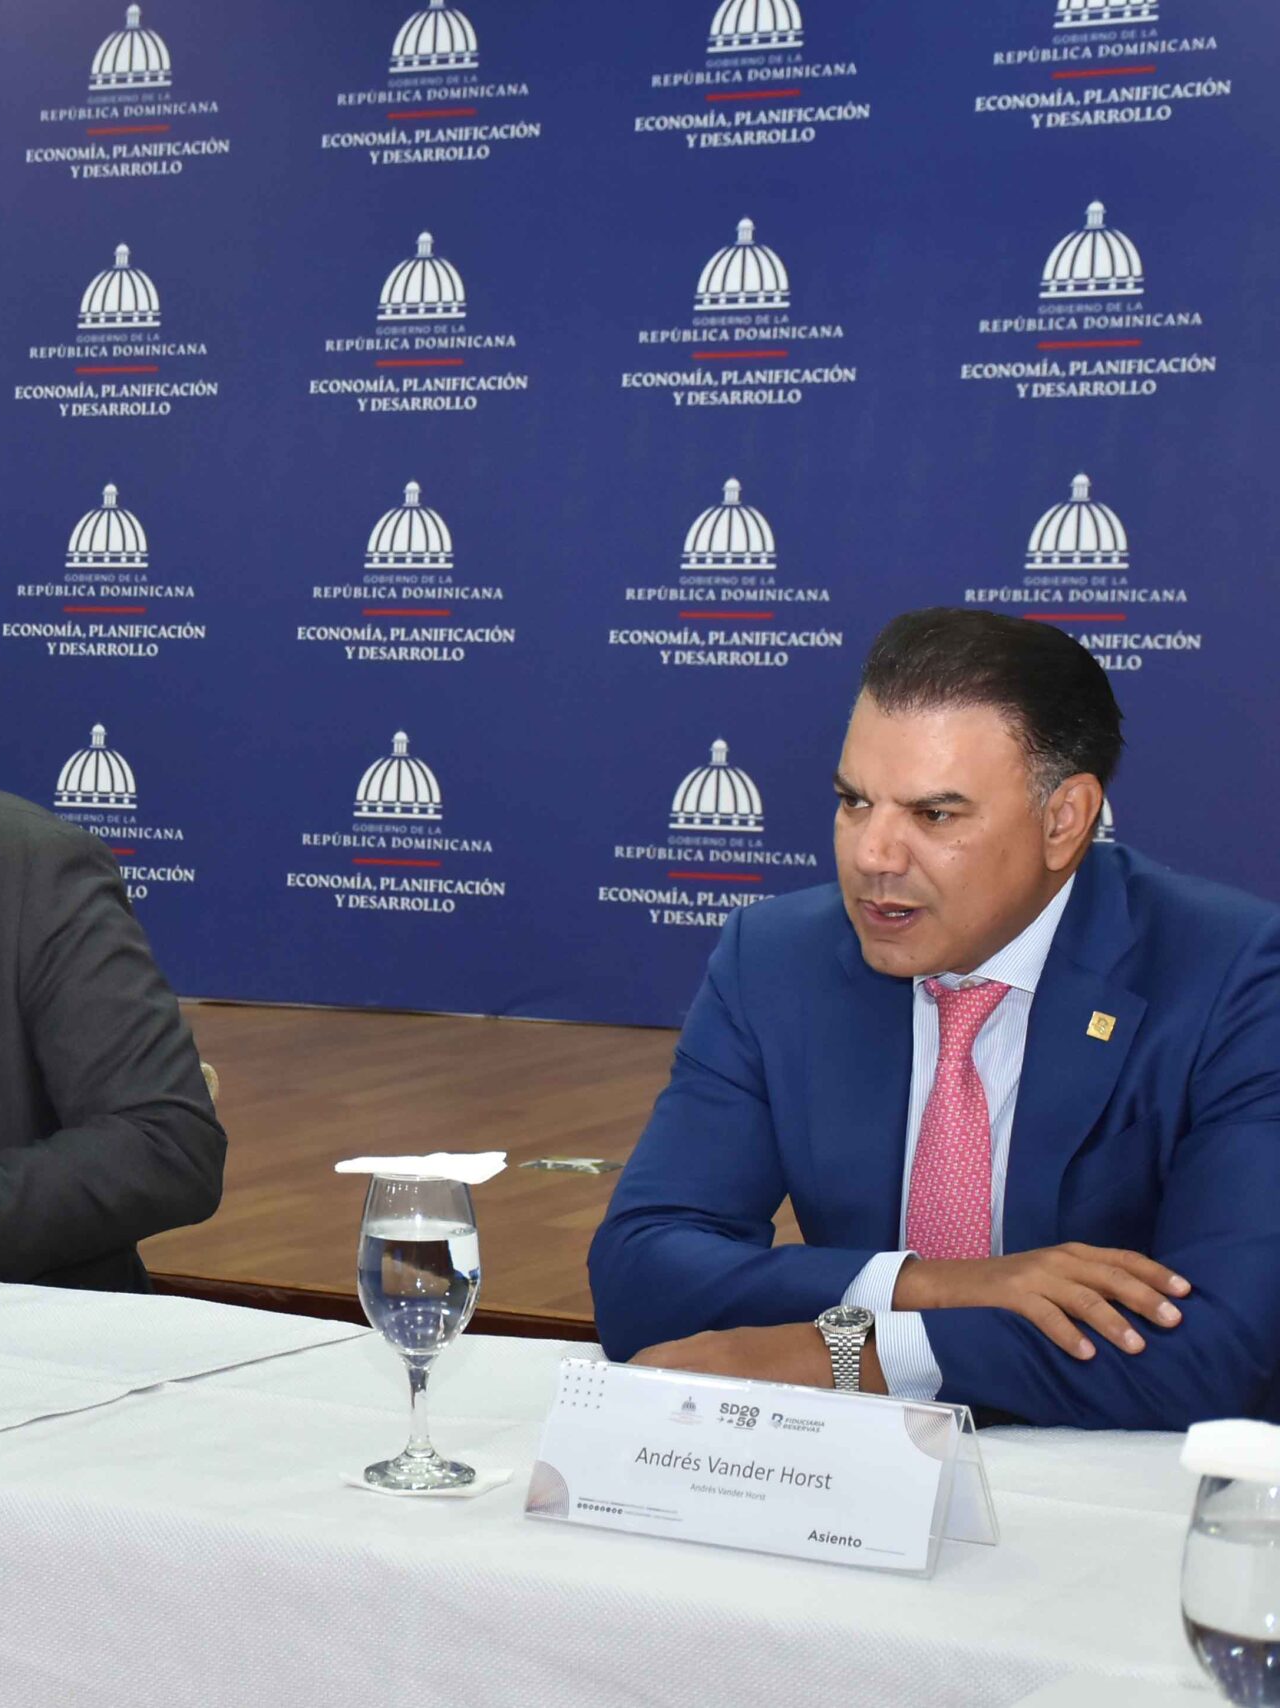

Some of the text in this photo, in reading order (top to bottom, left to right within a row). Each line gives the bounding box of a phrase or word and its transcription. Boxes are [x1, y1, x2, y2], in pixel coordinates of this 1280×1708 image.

[1052, 28, 1157, 44] GOBIERNO DE LA
[992, 36, 1217, 64] REPÚBLICA DOMINICANA
[705, 53, 802, 68] GOBIERNO DE LA
[387, 74, 477, 88] GOBIERNO DE LA
[651, 62, 857, 87] REPÚBLICA DOMINICANA
[86, 91, 170, 104] GOBIERNO DE LA
[336, 83, 528, 105] REPÚBLICA DOMINICANA
[974, 78, 1231, 111] ECONOMÍA, PLANIFICACIÓN
[39, 101, 218, 121] REPÚBLICA DOMINICANA
[634, 102, 870, 131] ECONOMÍA, PLANIFICACIÓN
[1030, 105, 1172, 128] Y DESARROLLO
[321, 121, 540, 148] ECONOMÍA, PLANIFICACIÓN
[685, 127, 815, 148] Y DESARROLLO
[25, 137, 229, 162] ECONOMÍA, PLANIFICACIÓN
[369, 145, 490, 164] Y DESARROLLO
[70, 160, 182, 178] Y DESARROLLO
[1037, 301, 1142, 314] GOBIERNO DE LA
[692, 314, 788, 326] GOBIERNO DE LA
[978, 312, 1202, 332] REPÚBLICA DOMINICANA
[75, 332, 159, 343] GOBIERNO DE LA
[375, 324, 465, 335] GOBIERNO DE LA
[638, 325, 843, 343] REPÚBLICA DOMINICANA
[29, 343, 207, 358] REPÚBLICA DOMINICANA
[324, 334, 516, 351] REPÚBLICA DOMINICANA
[960, 354, 1216, 379] ECONOMÍA, PLANIFICACIÓN
[309, 372, 528, 394] ECONOMÍA, PLANIFICACIÓN
[621, 364, 856, 387] ECONOMÍA, PLANIFICACIÓN
[14, 379, 218, 399] ECONOMÍA, PLANIFICACIÓN
[672, 388, 802, 405] Y DESARROLLO
[1016, 380, 1157, 398] Y DESARROLLO
[58, 401, 171, 416] Y DESARROLLO
[356, 395, 477, 411] Y DESARROLLO
[63, 573, 147, 582] GOBIERNO DE LA
[362, 574, 452, 584] GOBIERNO DE LA
[679, 575, 775, 585] GOBIERNO DE LA
[1023, 575, 1127, 586] GOBIERNO DE LA
[16, 582, 194, 597] REPÚBLICA DOMINICANA
[312, 584, 503, 599] REPÚBLICA DOMINICANA
[625, 585, 830, 601] REPÚBLICA DOMINICANA
[964, 588, 1187, 602] REPÚBLICA DOMINICANA
[2, 621, 206, 638] ECONOMÍA, PLANIFICACIÓN
[296, 623, 515, 642] ECONOMÍA, PLANIFICACIÓN
[608, 627, 842, 646] ECONOMÍA, PLANIFICACIÓN
[1068, 629, 1201, 649] ANIFICACIÓN
[46, 641, 158, 656] Y DESARROLLO
[344, 645, 465, 661] Y DESARROLLO
[659, 650, 788, 666] Y DESARROLLO
[54, 812, 136, 824] OBIERNO DE LA
[90, 825, 184, 840] DOMINICANA
[351, 823, 441, 835] GOBIERNO DE LA
[301, 832, 492, 852] REPÚBLICA DOMINICANA
[667, 835, 762, 847] GOBIERNO DE LA
[614, 845, 817, 865] REPÚBLICA DOMINICANA
[120, 864, 195, 882] IFICACIÓN
[286, 872, 505, 895] ECONOMÍA, PLANIFICACIÓN
[334, 894, 455, 912] Y DESARROLLO
[598, 886, 694, 907] ECONOMÍA,
[650, 909, 660, 924] Y
[720, 1403, 760, 1417] SD20
[736, 1417, 756, 1428] 50
[785, 1418, 825, 1427] FIDUCIARIA
[635, 1447, 833, 1490] Andrés Vander Horst
[690, 1483, 766, 1501] Andrés Vander Horst
[807, 1530, 862, 1548] Asiento
